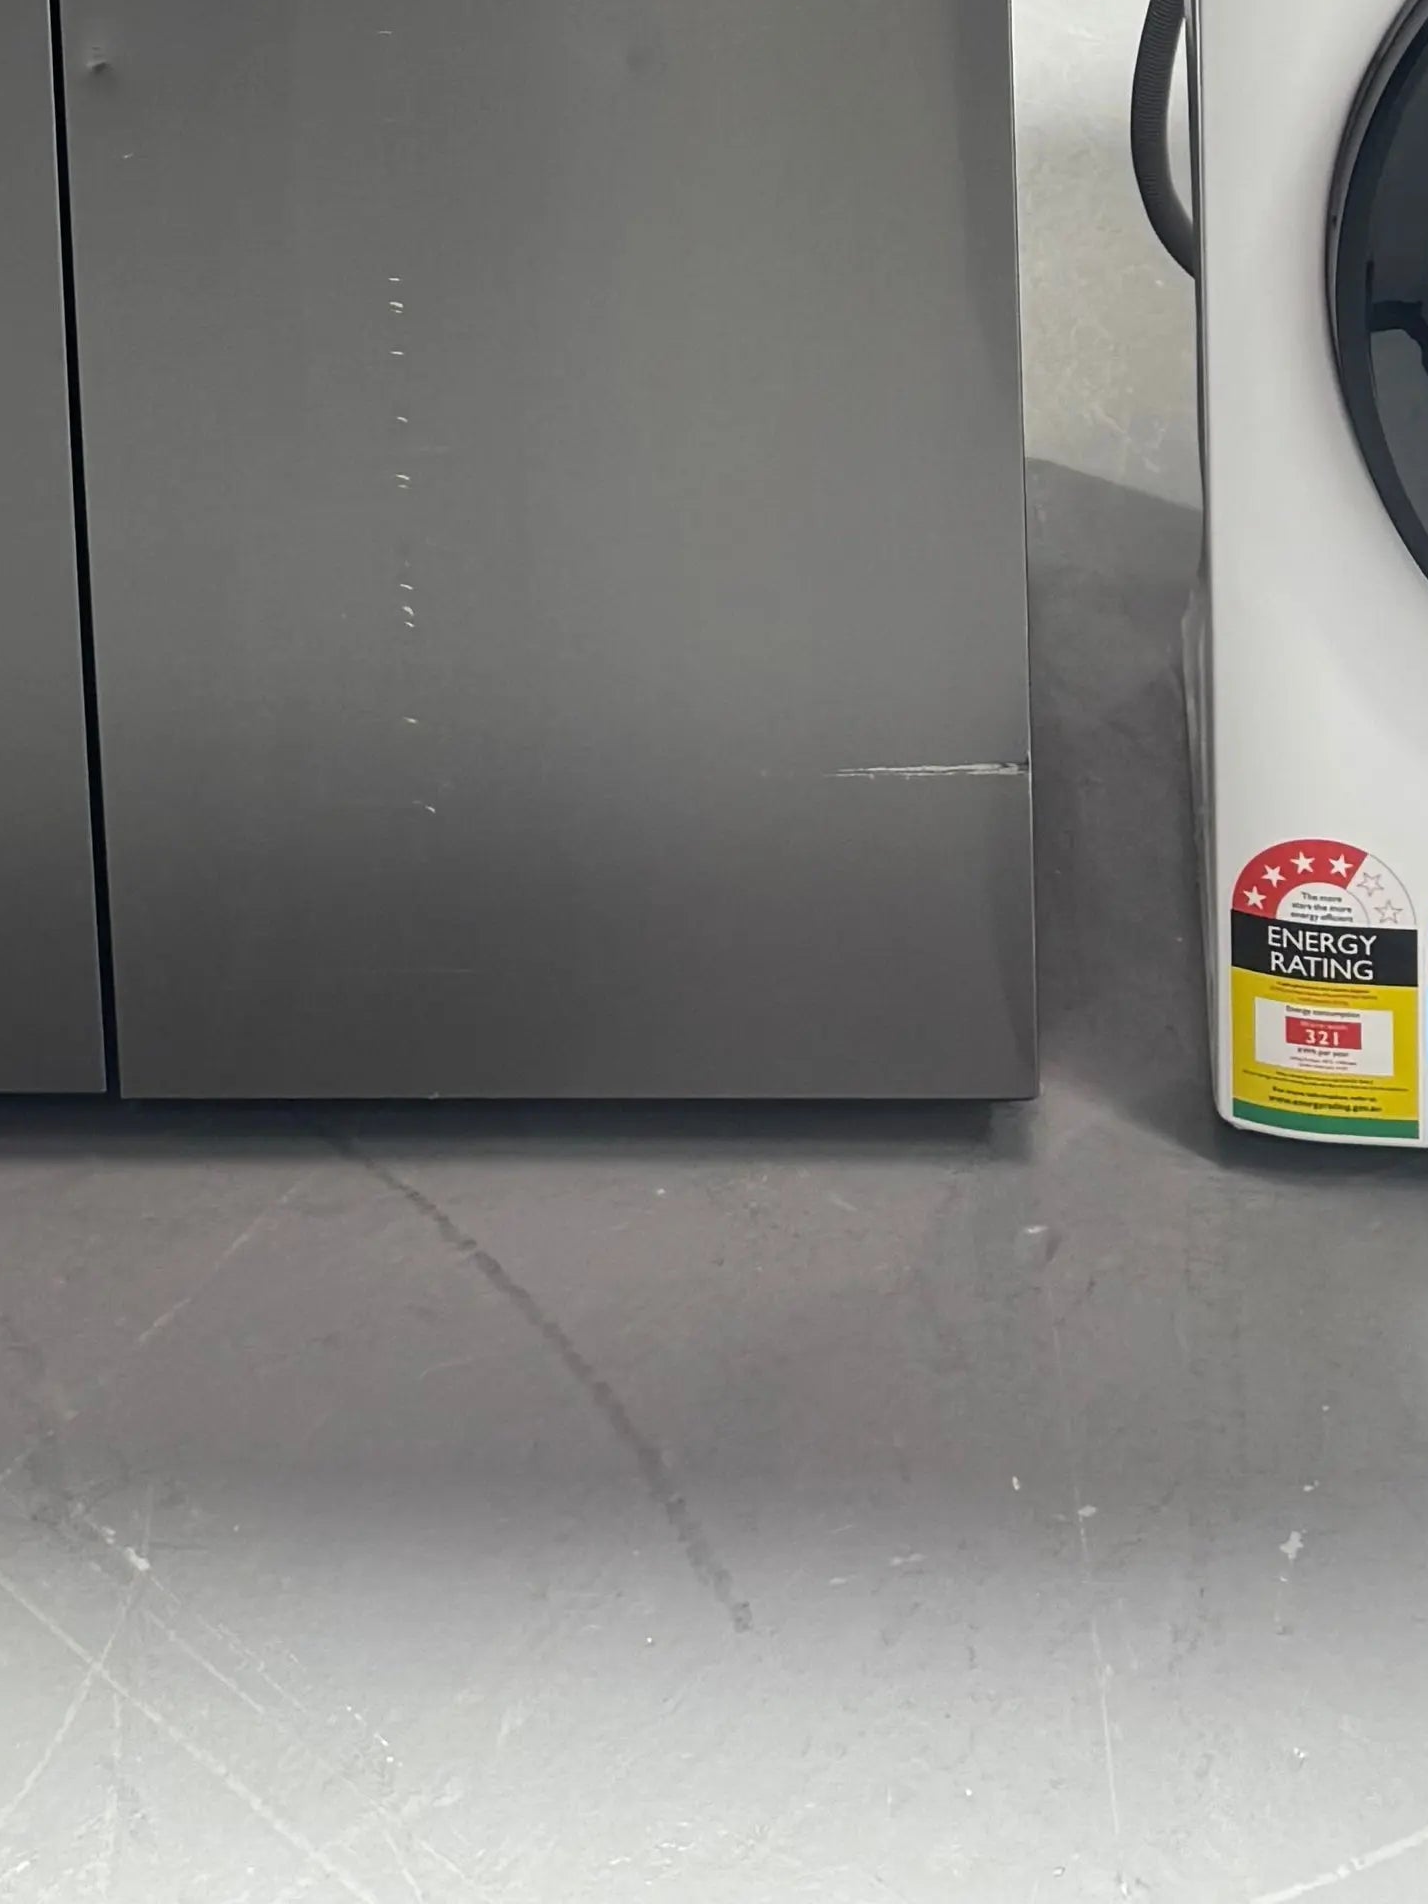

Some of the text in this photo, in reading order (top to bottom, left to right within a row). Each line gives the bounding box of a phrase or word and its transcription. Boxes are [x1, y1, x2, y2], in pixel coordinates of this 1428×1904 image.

[1267, 926, 1377, 956] ENERGY
[1270, 952, 1374, 981] RATING
[1305, 1029, 1339, 1046] 321
